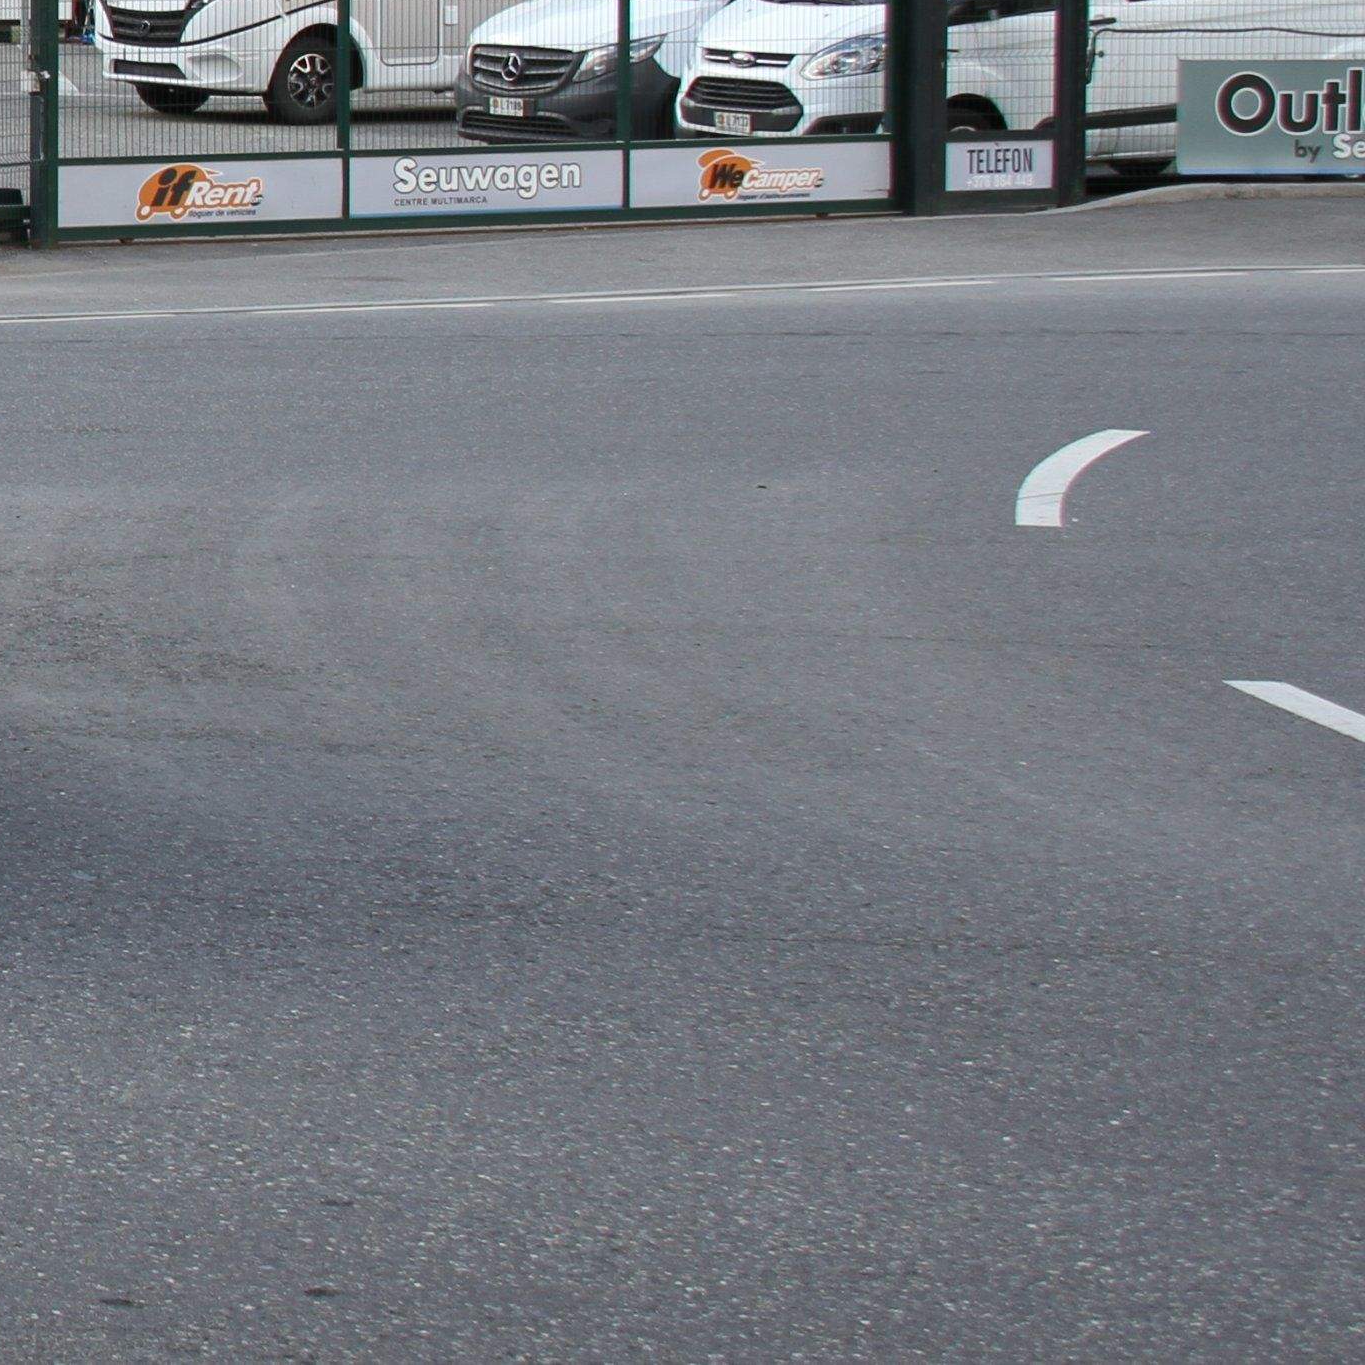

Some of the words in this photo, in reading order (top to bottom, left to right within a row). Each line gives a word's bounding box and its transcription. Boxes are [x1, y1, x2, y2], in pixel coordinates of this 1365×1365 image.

[1214, 66, 1365, 136] Outl
[967, 142, 1033, 174] TELÈFON
[1294, 138, 1322, 164] by
[393, 156, 581, 200] Seuwagen
[394, 198, 428, 207] CENTRE
[430, 196, 488, 206] MULTIMARCA
